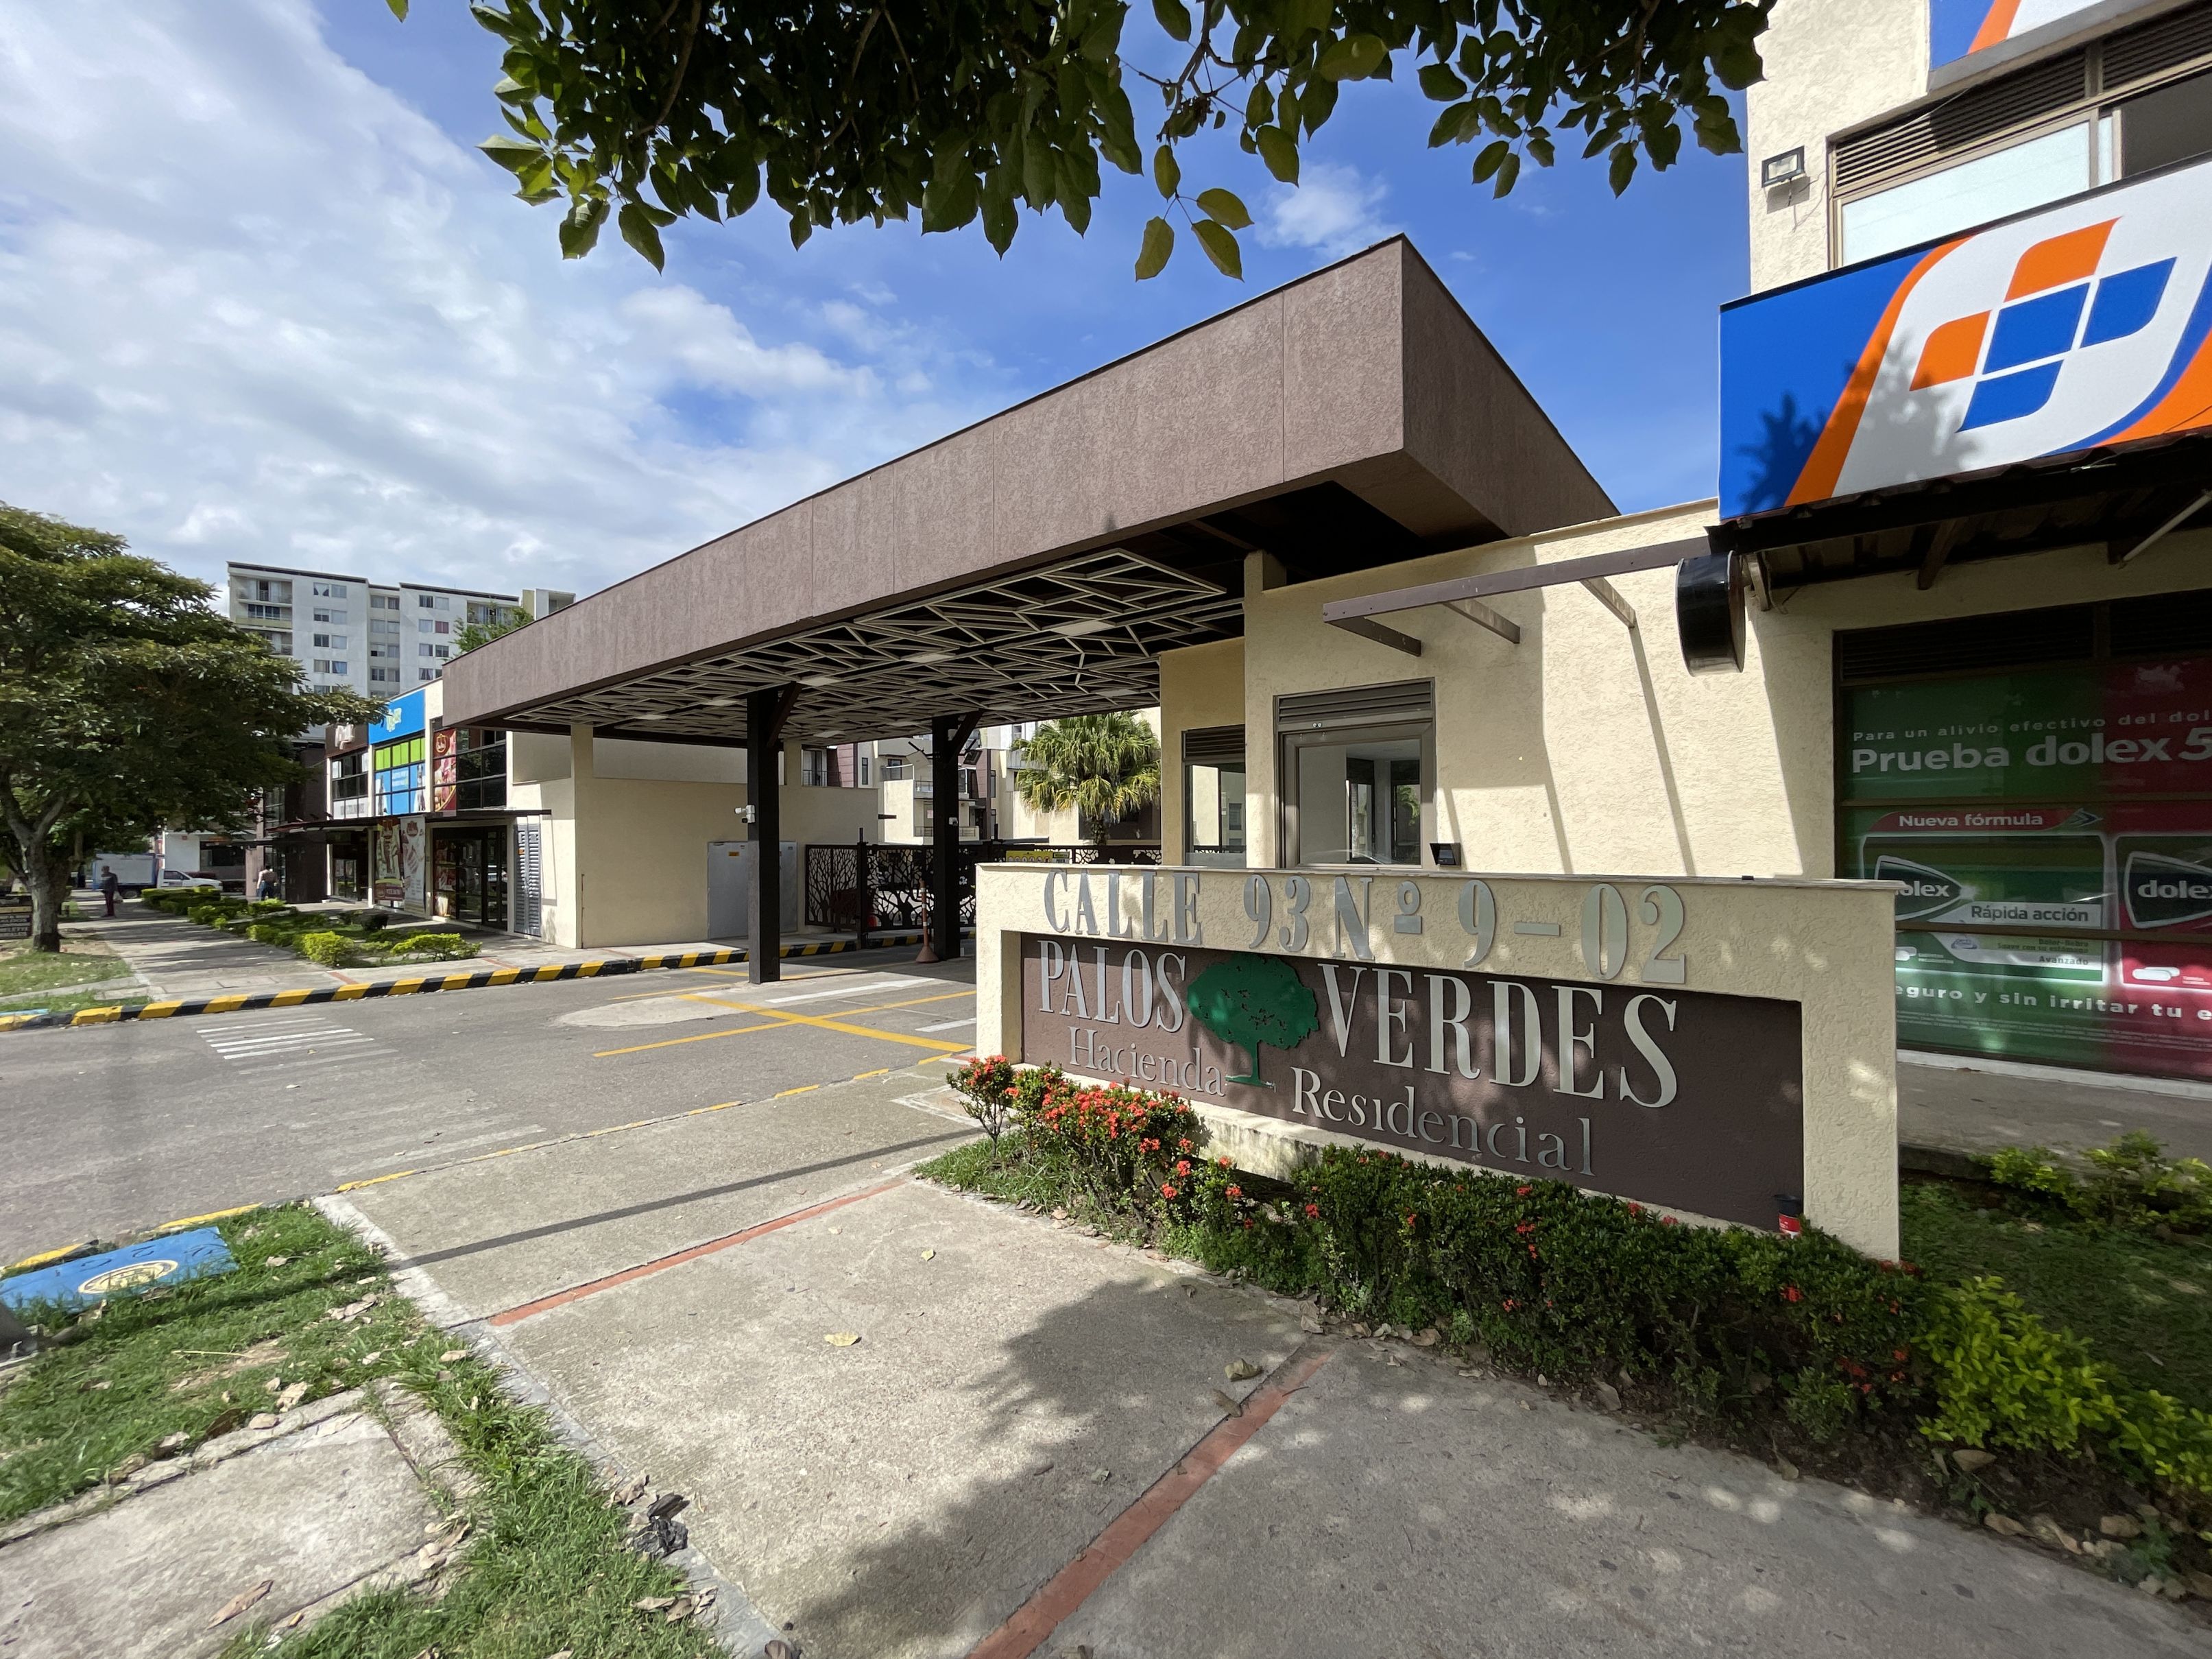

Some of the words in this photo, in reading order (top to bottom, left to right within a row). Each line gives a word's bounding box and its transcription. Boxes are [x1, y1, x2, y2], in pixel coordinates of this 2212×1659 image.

[1853, 729, 1895, 741] Para
[1905, 726, 1927, 738] un
[1938, 723, 1999, 737] alivio
[2010, 716, 2106, 732] efectivo
[2118, 713, 2156, 726] del
[1852, 743, 2010, 773] Prueba
[2025, 732, 2173, 767] dolex
[1899, 814, 1958, 827] Nueva
[1964, 811, 2043, 826] fórmula
[1899, 880, 1950, 898] olex
[2137, 879, 2212, 899] dole
[1043, 868, 1202, 946] CALLE
[1243, 874, 1311, 953] 93
[1971, 905, 2028, 923] Rápida
[2032, 907, 2089, 922] acción
[2039, 955, 2089, 966] Avanzado
[1896, 986, 1962, 999] eguro
[1974, 992, 1987, 1003] y
[1999, 992, 2037, 1007] sin
[2050, 995, 2138, 1014] irritar
[2151, 1003, 2182, 1018] tu
[1037, 940, 1188, 1033] PALOS
[1317, 962, 1678, 1108] VERDES
[1068, 1026, 1225, 1097] Hacienda
[1290, 1066, 1596, 1176] Residencial
